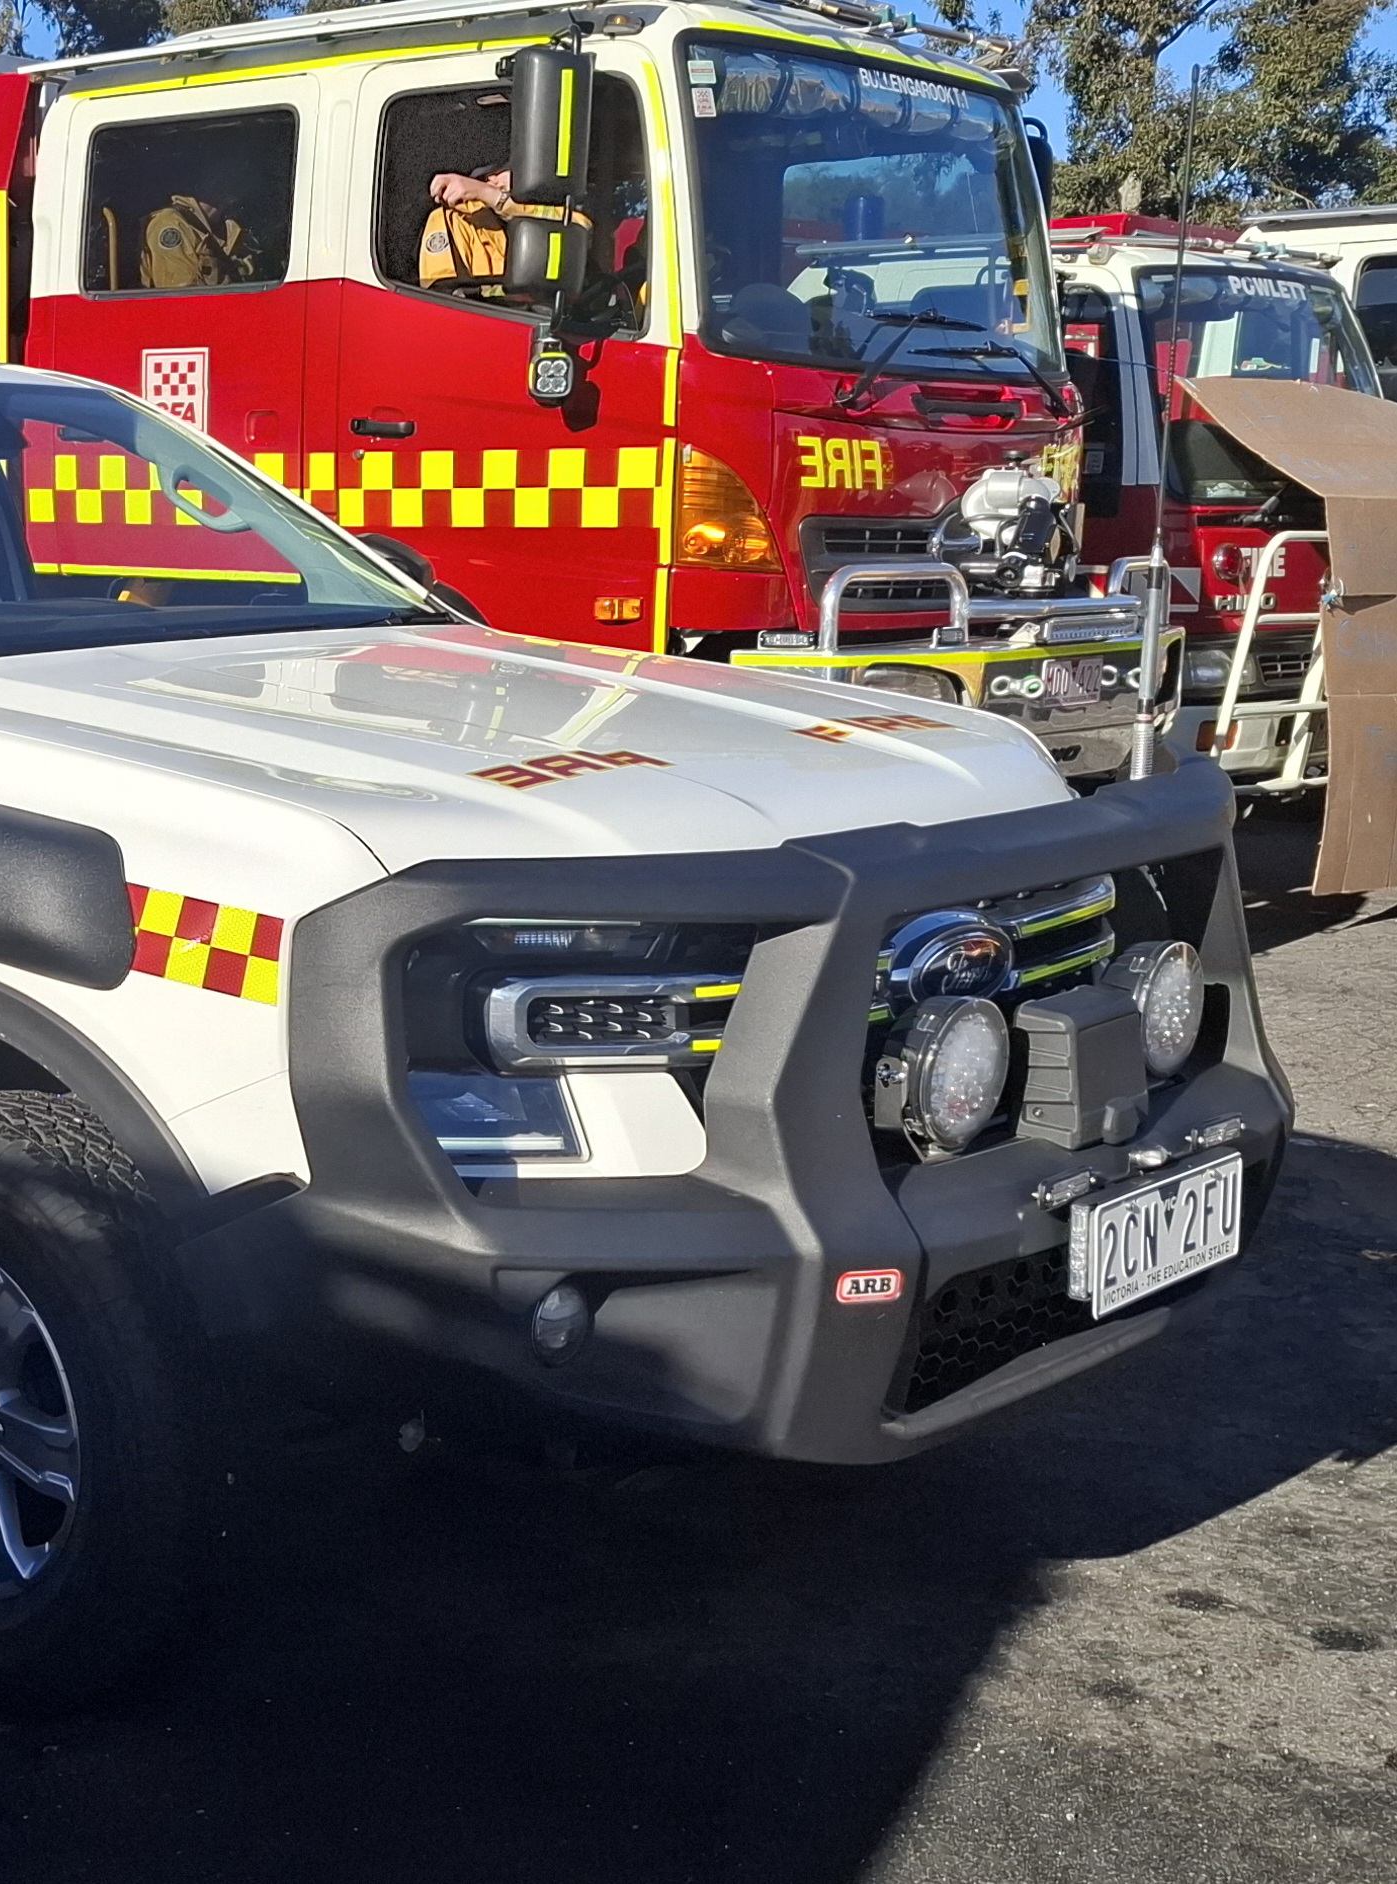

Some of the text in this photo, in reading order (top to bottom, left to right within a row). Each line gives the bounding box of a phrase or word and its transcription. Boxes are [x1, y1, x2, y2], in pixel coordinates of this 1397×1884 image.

[858, 67, 955, 105] BULLENGAROOK
[1227, 275, 1307, 301] POWLETT
[1215, 593, 1277, 611] HIO
[787, 714, 959, 744] FIRE
[1101, 1171, 1236, 1290] 2CN 2FU
[846, 1277, 892, 1295] ARB
[1103, 1279, 1140, 1307] VICTORIA
[1146, 1269, 1162, 1287] THE
[1163, 1252, 1206, 1280] EDUCATION
[1208, 1240, 1231, 1261] STATE
